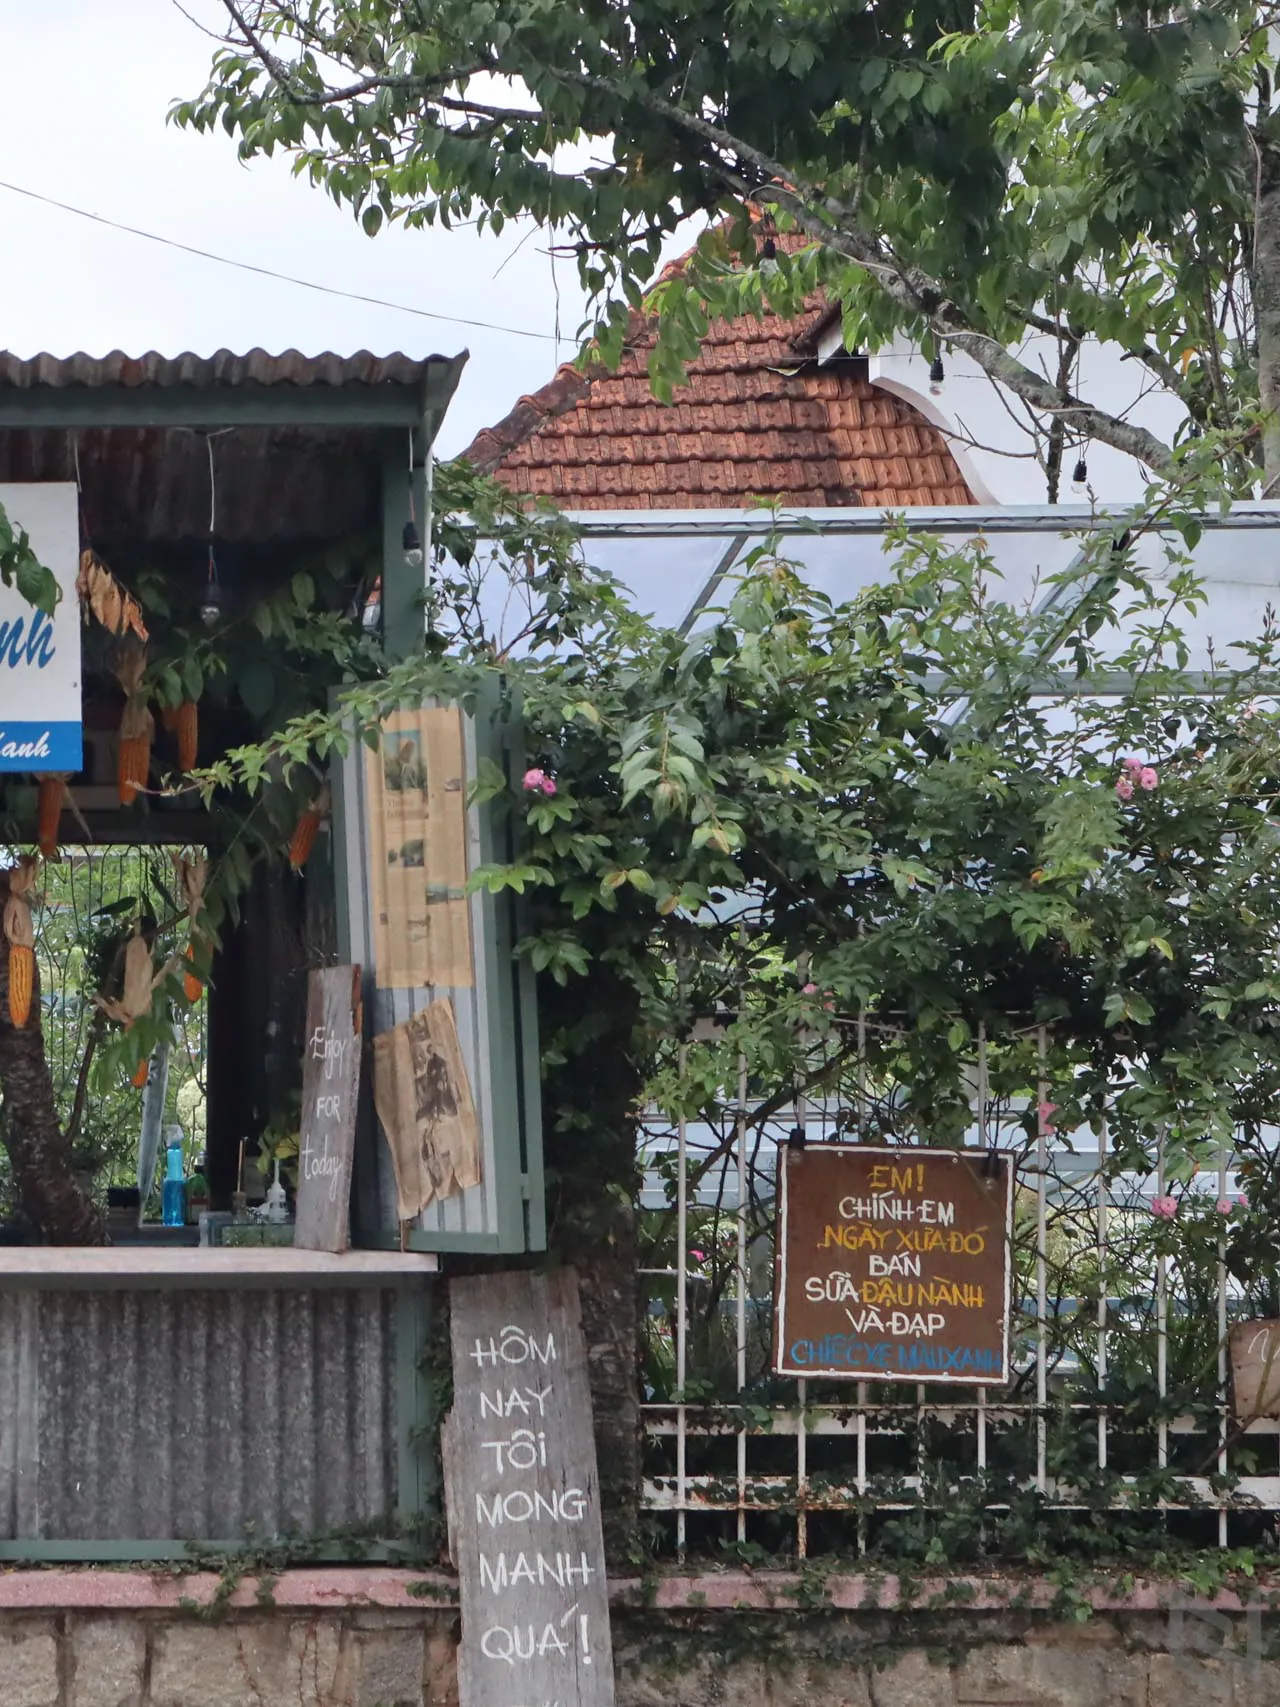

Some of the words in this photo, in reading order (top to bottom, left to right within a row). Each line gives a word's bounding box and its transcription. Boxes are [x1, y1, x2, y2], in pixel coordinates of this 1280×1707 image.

[309, 1026, 347, 1080] Enjoy
[316, 1096, 341, 1123] FOR
[301, 1134, 342, 1201] today
[867, 1164, 925, 1195] EM!
[838, 1190, 915, 1221] CHÍNH
[916, 1200, 955, 1227] EM
[817, 1221, 893, 1250] NGÀY
[947, 1226, 988, 1255] ĐÓ
[869, 1251, 921, 1277] BÁN
[805, 1271, 859, 1303] SỮA
[919, 1276, 985, 1308] NÀNH
[845, 1304, 886, 1333] VÀ
[886, 1311, 946, 1338] ĐẠP
[470, 1325, 557, 1367] HÔM
[864, 1342, 893, 1367] XE
[480, 1385, 553, 1419] NAY
[475, 1489, 588, 1528] MONG
[479, 1551, 595, 1595] MANH
